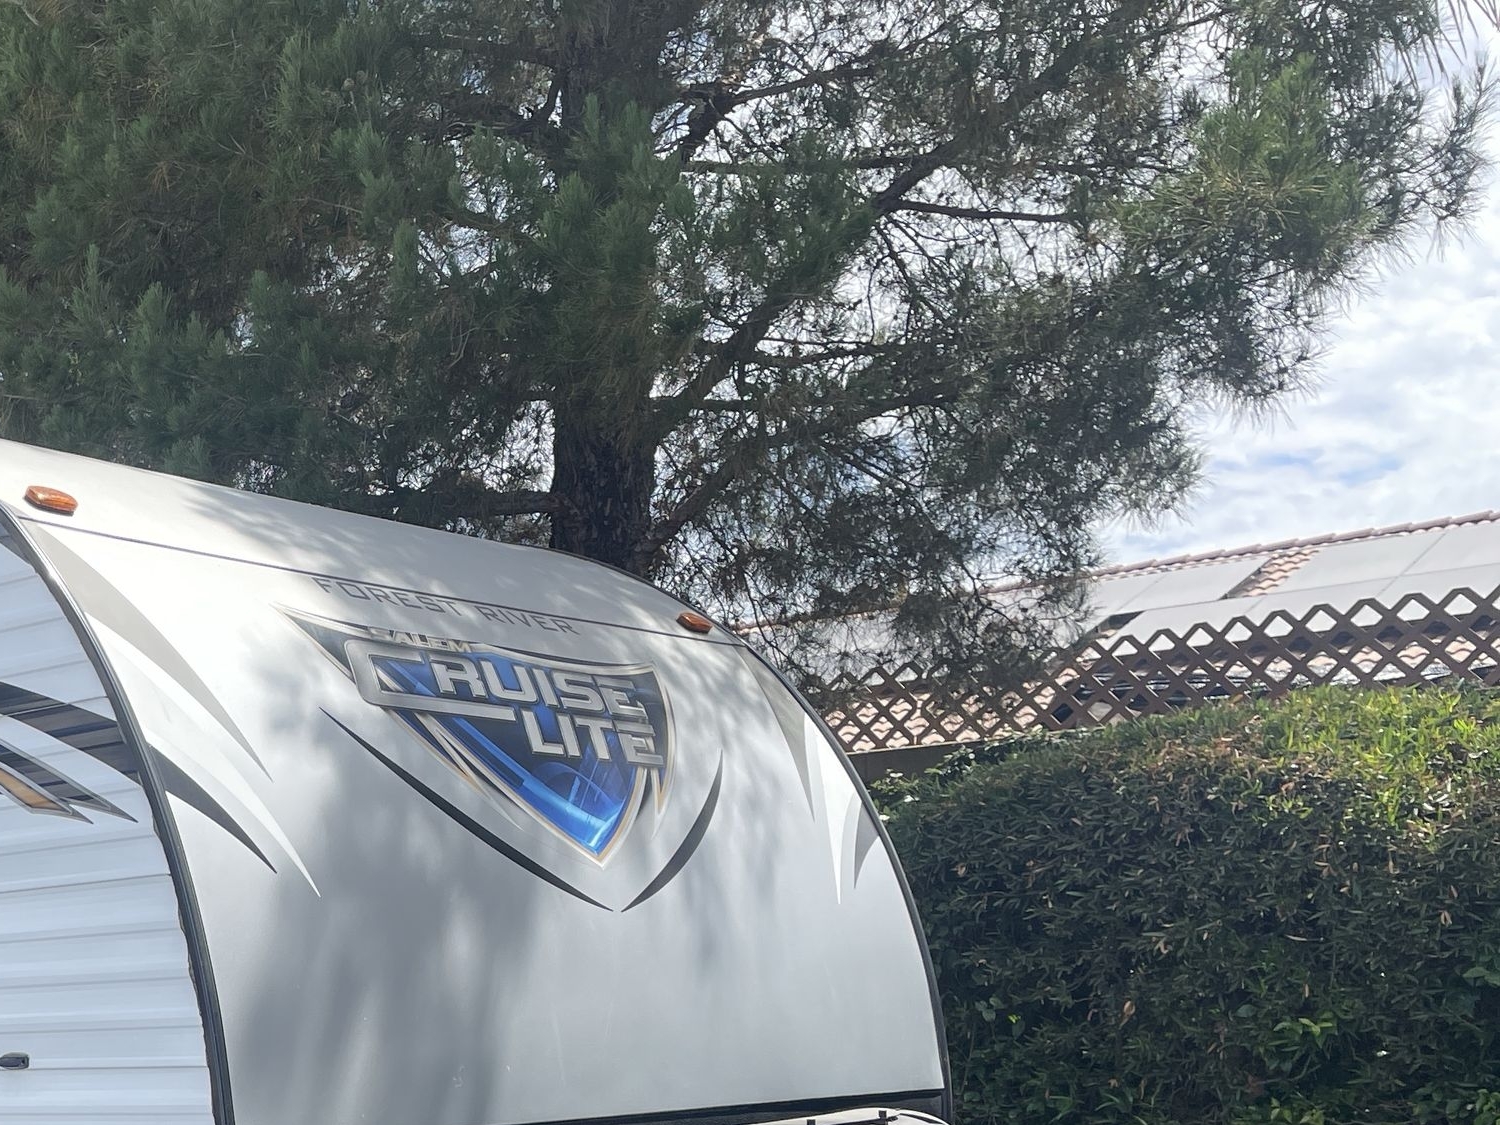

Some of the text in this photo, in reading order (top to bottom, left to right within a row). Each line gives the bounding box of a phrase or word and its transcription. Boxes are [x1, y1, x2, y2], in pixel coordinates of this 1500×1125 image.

[311, 577, 580, 636] FOREST RIVER
[368, 626, 473, 654] SALEM
[345, 639, 649, 722] CRUISE
[520, 706, 666, 767] LITE
